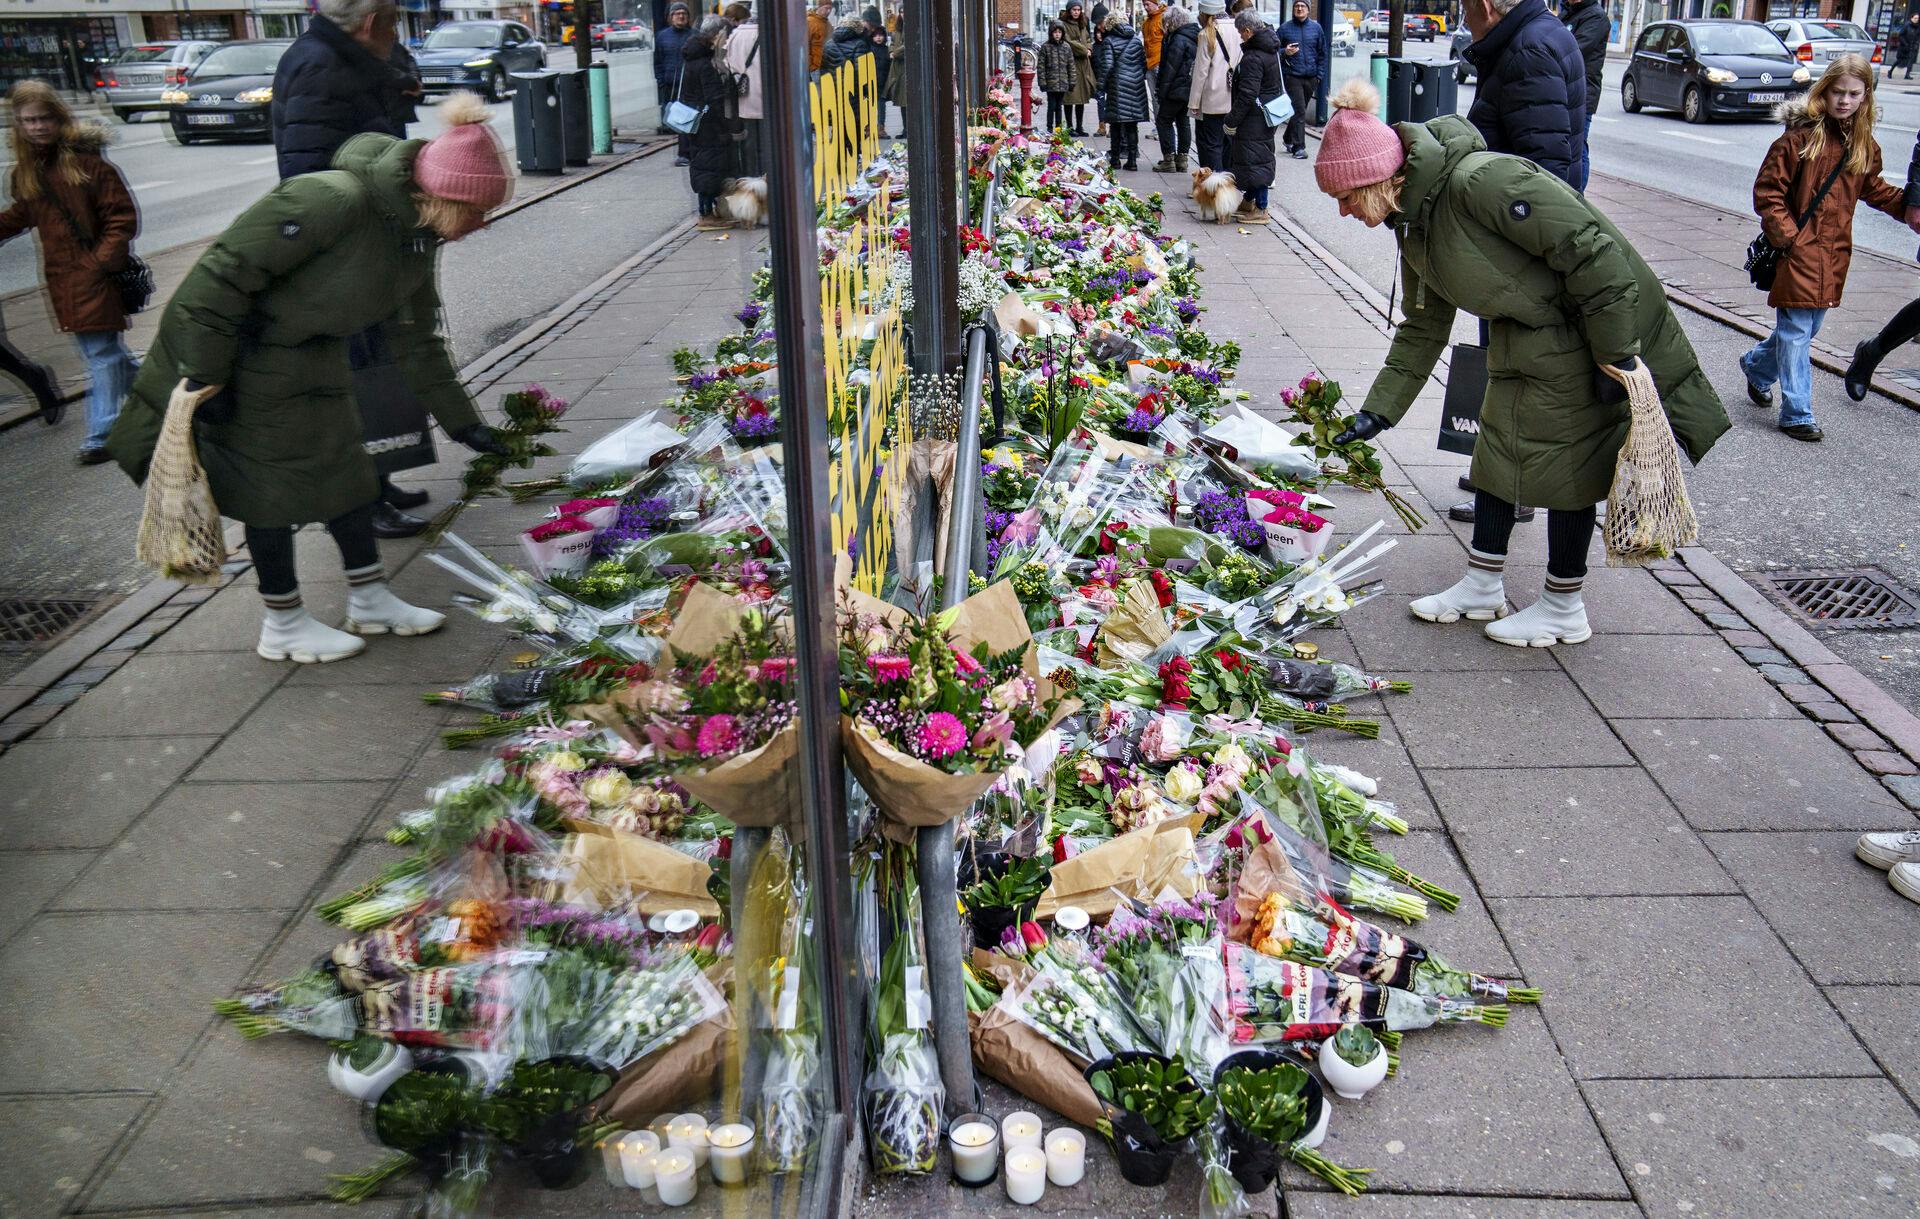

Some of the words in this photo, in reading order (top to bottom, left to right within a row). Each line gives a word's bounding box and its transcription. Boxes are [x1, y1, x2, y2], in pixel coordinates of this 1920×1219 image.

[857, 52, 880, 171] ER
[821, 218, 865, 421] KKE
[1452, 416, 1480, 434] VAN
[1266, 531, 1294, 545] ueen
[1298, 993, 1307, 1019] AFRI
